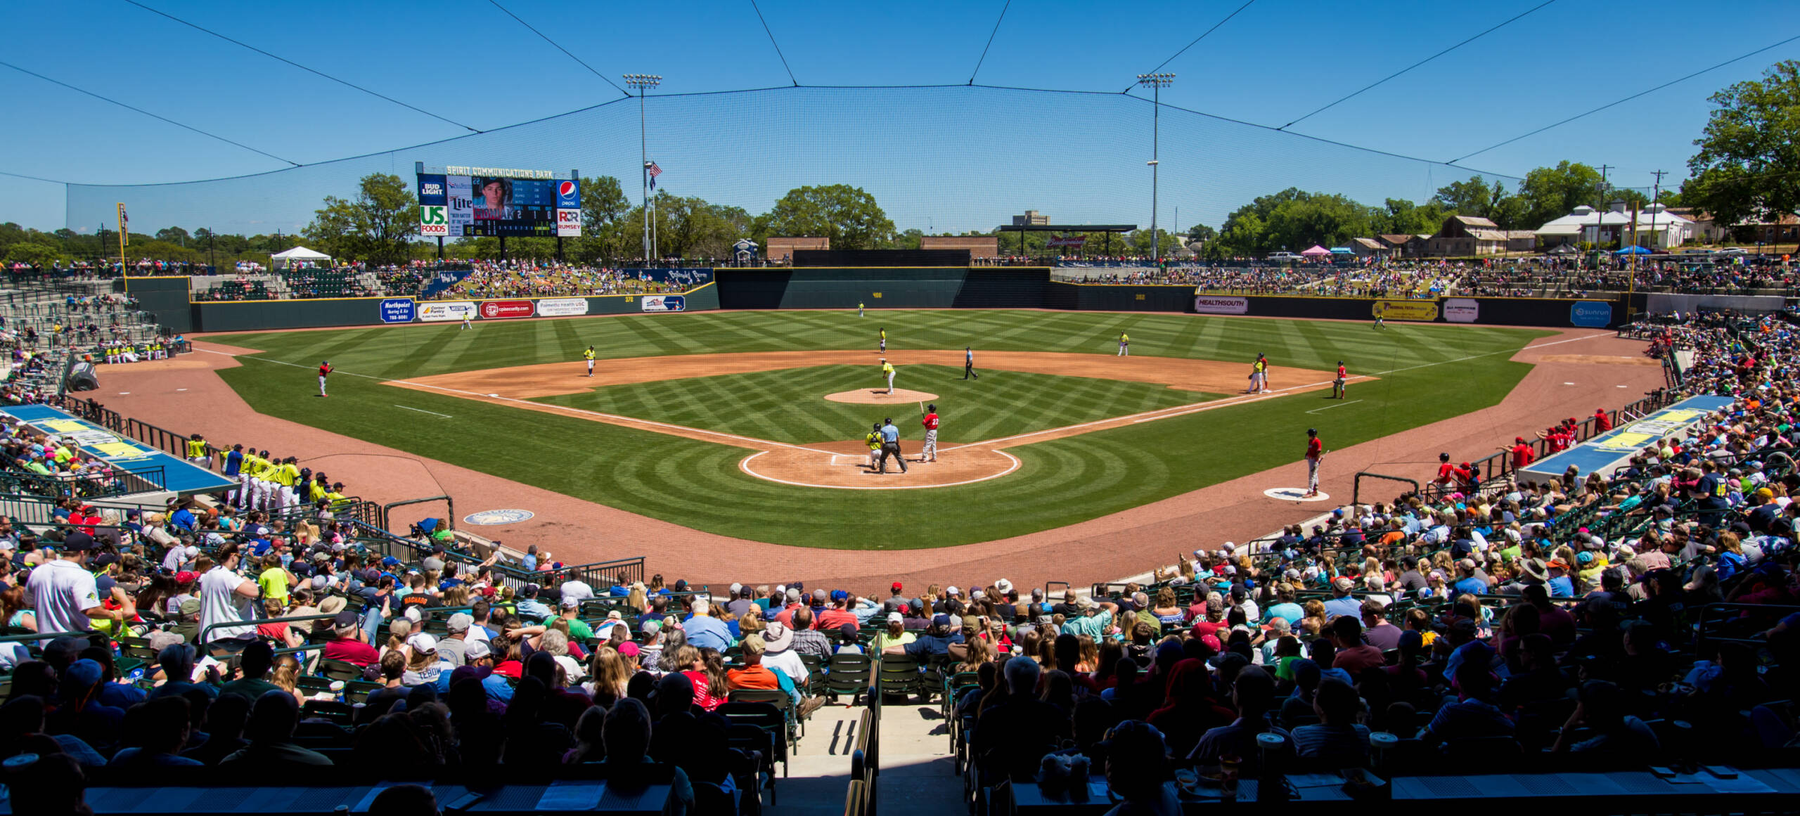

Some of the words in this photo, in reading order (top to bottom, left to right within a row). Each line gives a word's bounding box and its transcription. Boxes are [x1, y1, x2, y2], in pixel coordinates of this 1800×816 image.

[446, 165, 470, 175] SPIRIT
[472, 166, 533, 178] COMMUNICATIONS
[534, 169, 553, 179] PARK
[452, 197, 473, 211] Lite
[474, 208, 514, 220] MONIAK
[1198, 299, 1244, 307] HEALTHSOUTH
[404, 596, 428, 605] MACHADO
[419, 667, 442, 680] TEBOW
